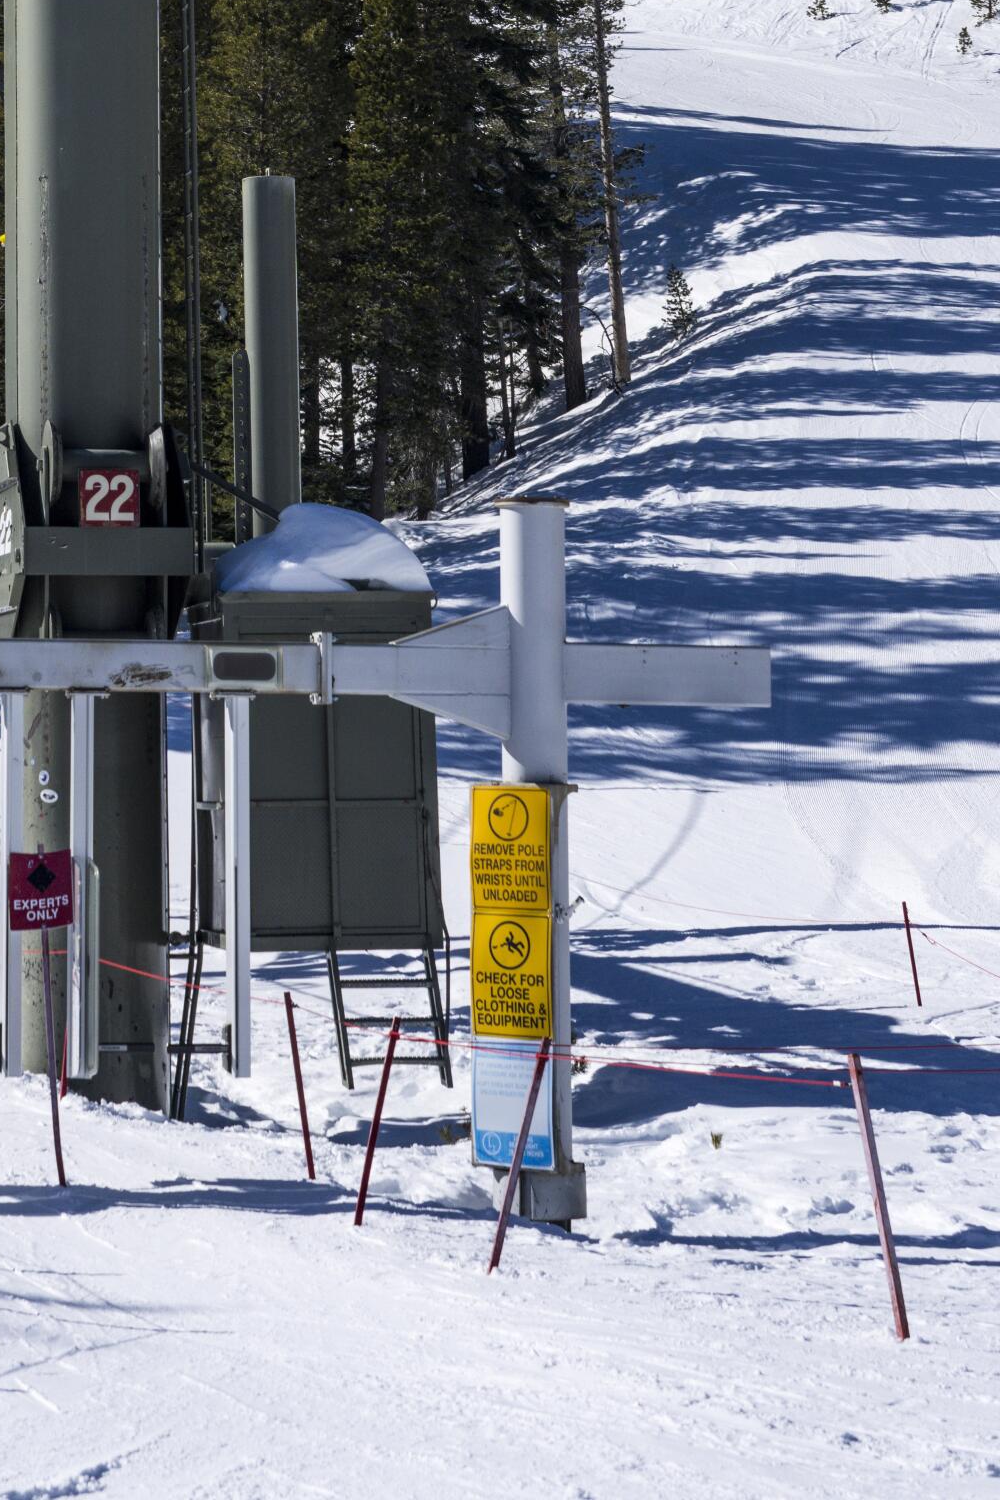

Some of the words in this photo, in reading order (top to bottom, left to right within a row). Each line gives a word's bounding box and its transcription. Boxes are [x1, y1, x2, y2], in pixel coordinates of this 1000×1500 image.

[84, 474, 135, 522] 22
[473, 843, 515, 856] REMOVE
[517, 845, 545, 857] POLE
[473, 858, 513, 871] STRAPS
[514, 860, 545, 872] FROM
[475, 873, 513, 887] WRISTS
[514, 875, 545, 888] UNTIL
[13, 894, 69, 911] EXPERTS
[483, 888, 538, 902] UNLOADED
[26, 908, 59, 922] ONLY
[475, 971, 517, 986] CHECK
[520, 974, 545, 987] FOR
[490, 986, 530, 1000] LOOSE
[475, 999, 535, 1015] CLOTHING
[538, 1003, 547, 1016] &
[477, 1013, 546, 1029] EQUIPMENT
